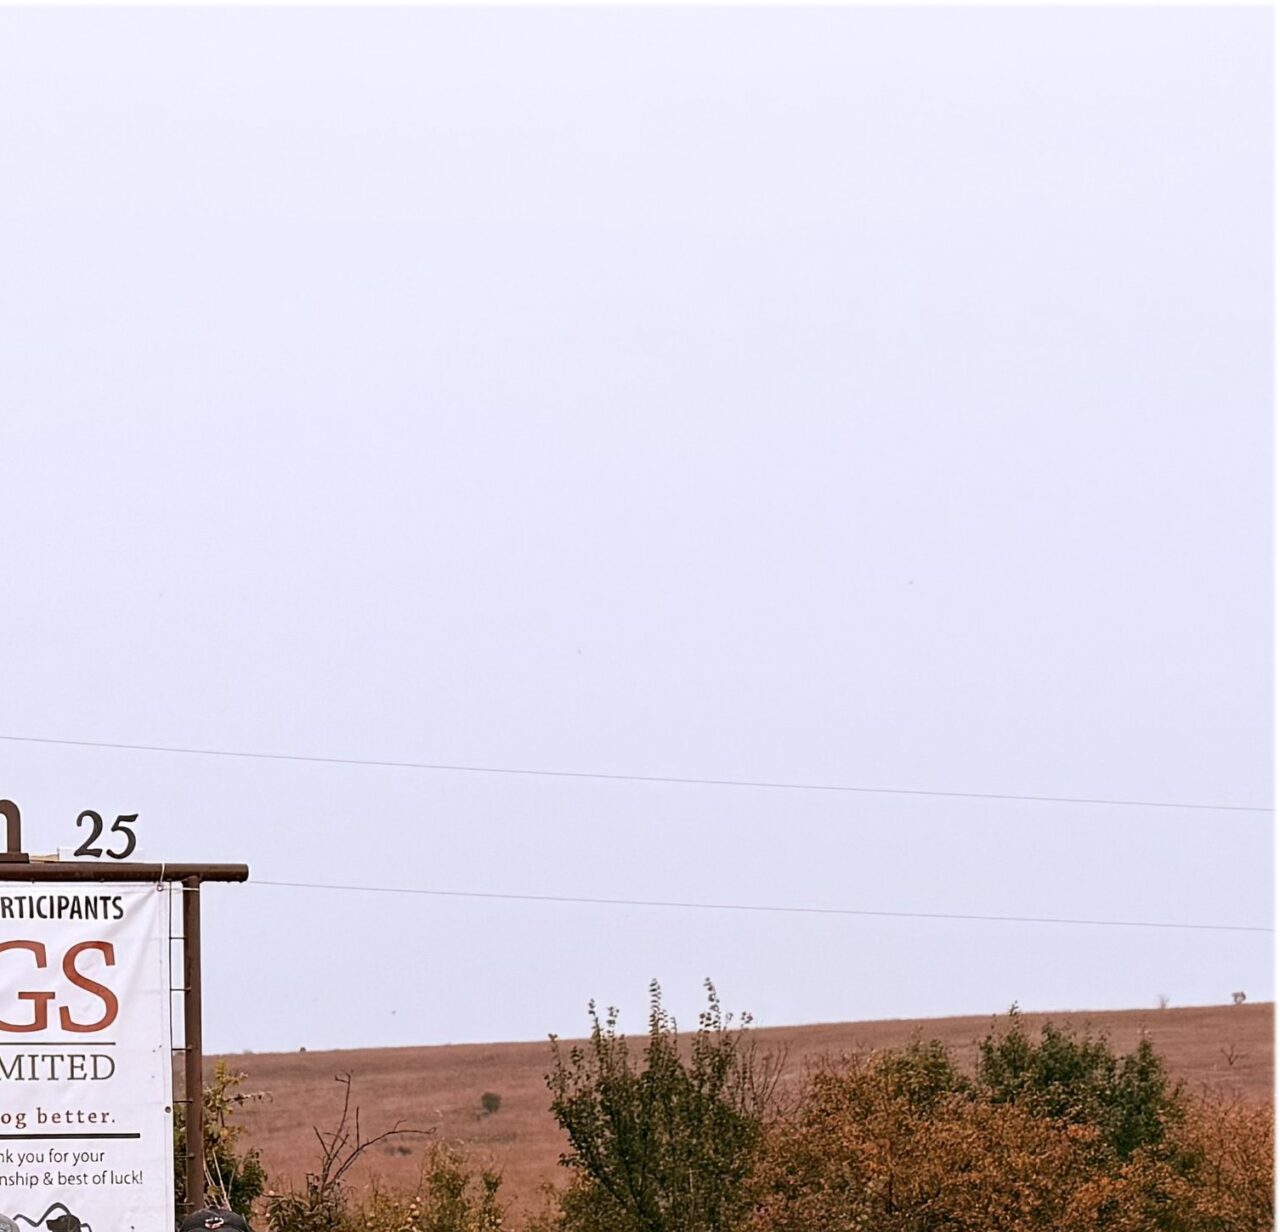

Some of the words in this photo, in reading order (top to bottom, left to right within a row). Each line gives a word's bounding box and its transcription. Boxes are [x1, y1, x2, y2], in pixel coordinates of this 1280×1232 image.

[73, 810, 139, 859] 25
[36, 1106, 117, 1126] better.
[18, 1151, 45, 1167] you
[49, 1148, 68, 1164] for
[72, 1151, 106, 1167] your
[43, 1171, 54, 1186] &
[58, 1170, 89, 1185] best
[92, 1170, 108, 1185] of
[110, 1170, 144, 1185] luck!
